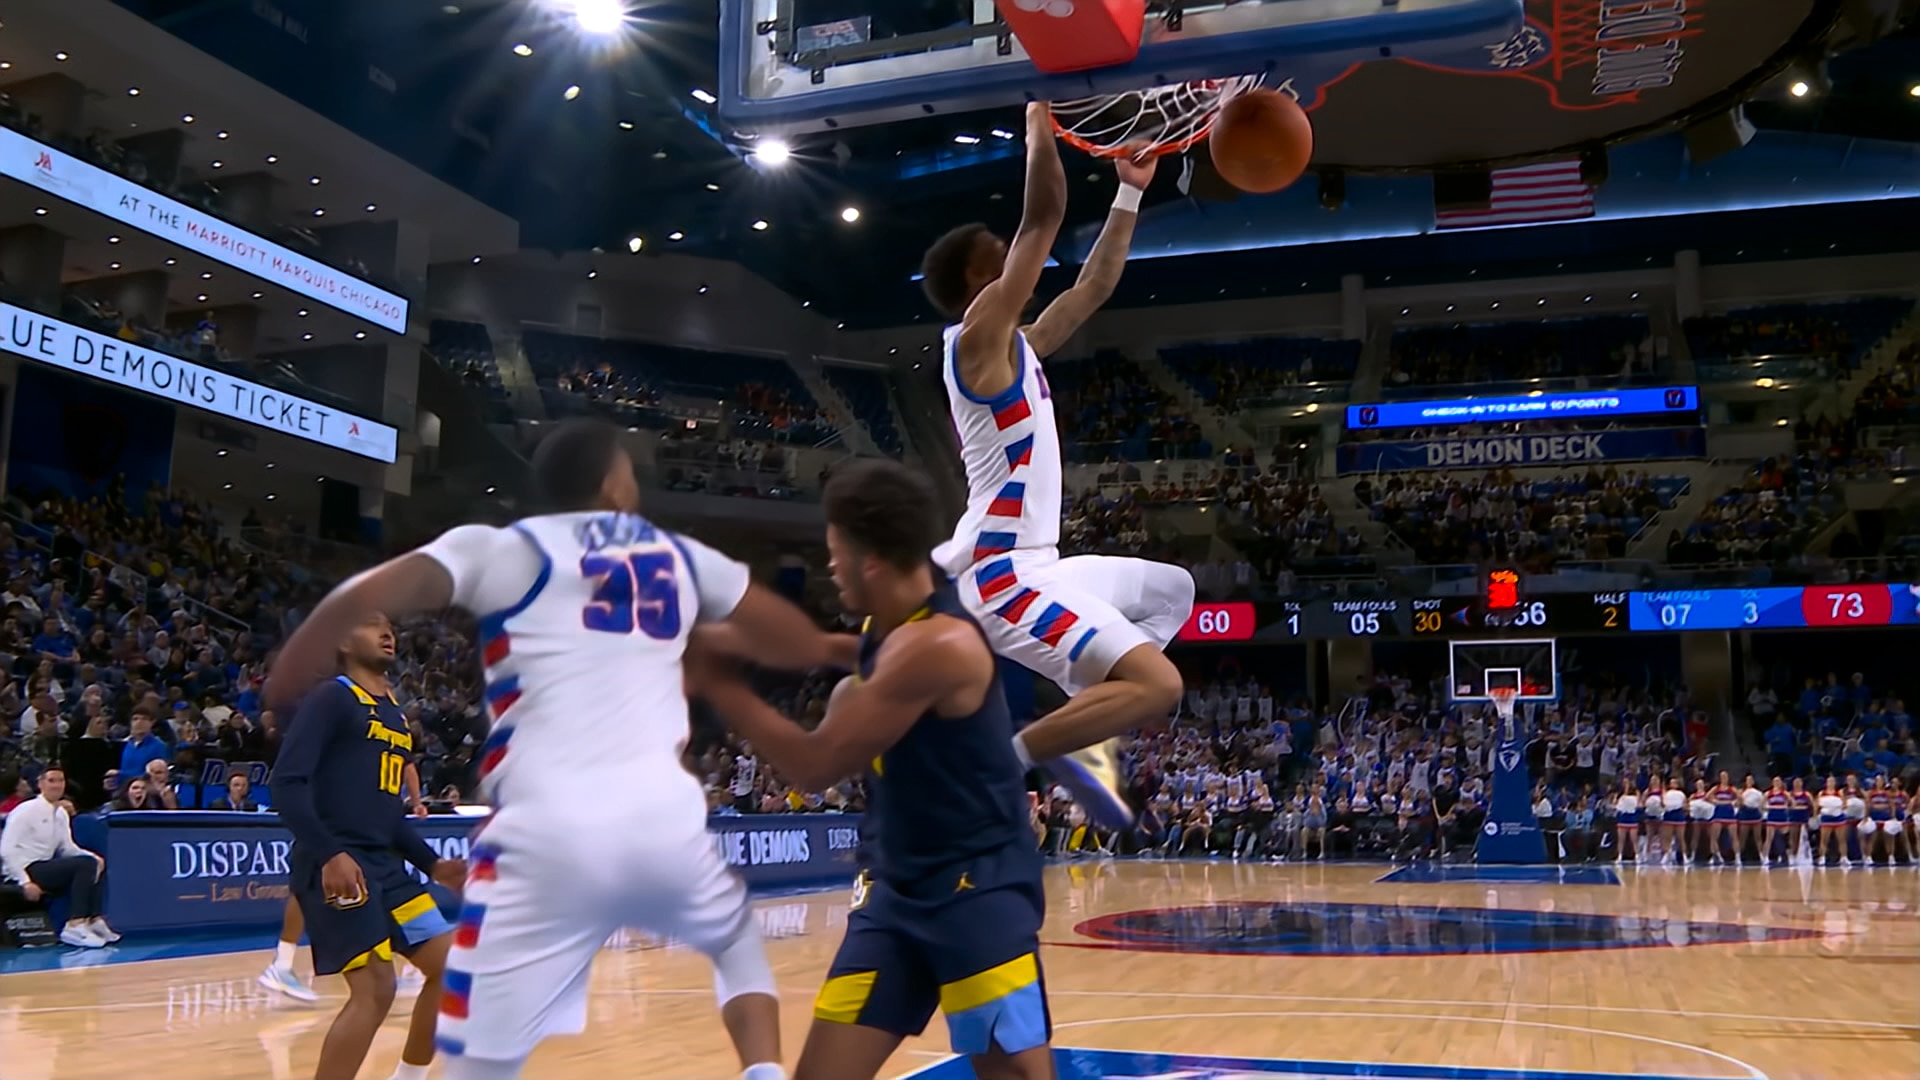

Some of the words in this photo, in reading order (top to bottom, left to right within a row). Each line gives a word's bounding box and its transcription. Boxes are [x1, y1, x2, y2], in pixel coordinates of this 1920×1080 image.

[119, 193, 140, 212] AT
[148, 203, 180, 229] THE
[185, 220, 267, 263] MARRIOTT
[272, 256, 336, 293] MARQUIS
[340, 284, 401, 319] CHICAGO
[0, 314, 57, 357] UE
[73, 343, 217, 404] DEMONS
[230, 383, 331, 437] TICKET
[1427, 437, 1524, 466] DEMON
[1530, 434, 1605, 461] DECK
[579, 550, 681, 641] 35
[1826, 592, 1865, 619] 73
[1199, 610, 1230, 635] 60
[1287, 613, 1299, 635] 1
[1351, 612, 1380, 635] 05
[1414, 611, 1442, 633] 30
[1602, 606, 1619, 628] 2
[1661, 603, 1692, 627] 07
[1743, 601, 1760, 625] 3
[380, 751, 405, 795] 10
[171, 839, 295, 878] DISPAR
[749, 829, 810, 865] DEMONS
[211, 882, 241, 902] Law
